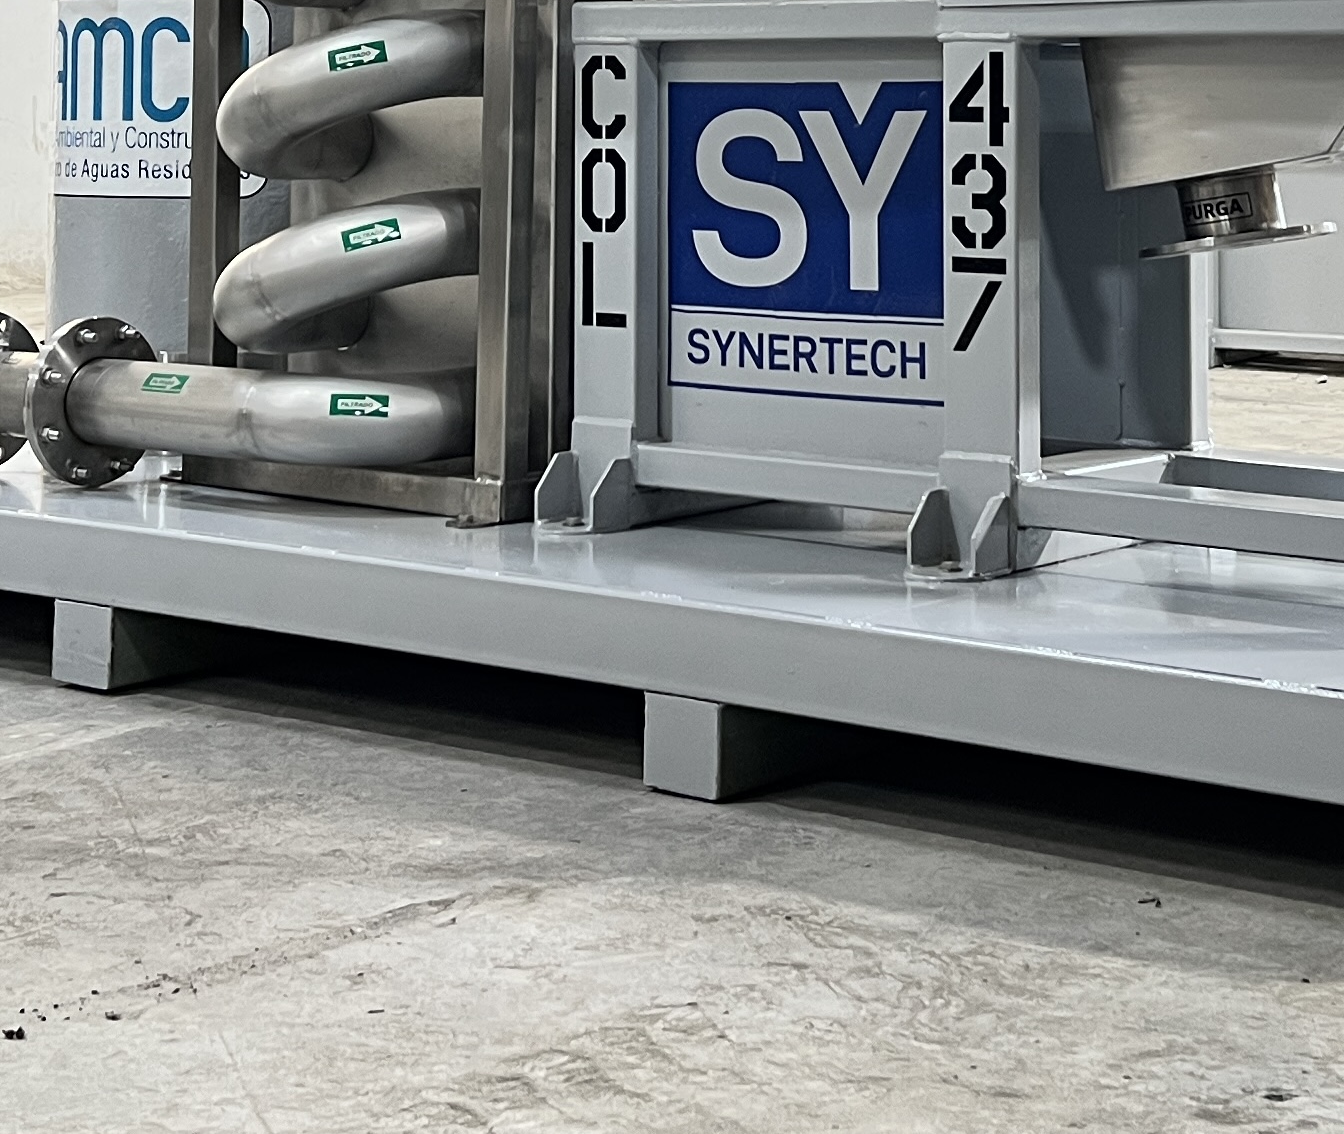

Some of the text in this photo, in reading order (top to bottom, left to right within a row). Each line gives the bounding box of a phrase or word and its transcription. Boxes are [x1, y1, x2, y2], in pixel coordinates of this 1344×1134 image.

[110, 130, 120, 154] y
[65, 158, 77, 178] de
[81, 158, 130, 183] Aguas
[581, 55, 627, 328] COL
[692, 108, 928, 291] SY
[949, 51, 1010, 352] 437
[1186, 198, 1244, 222] PURGA
[687, 327, 927, 380] SYNERTECH
